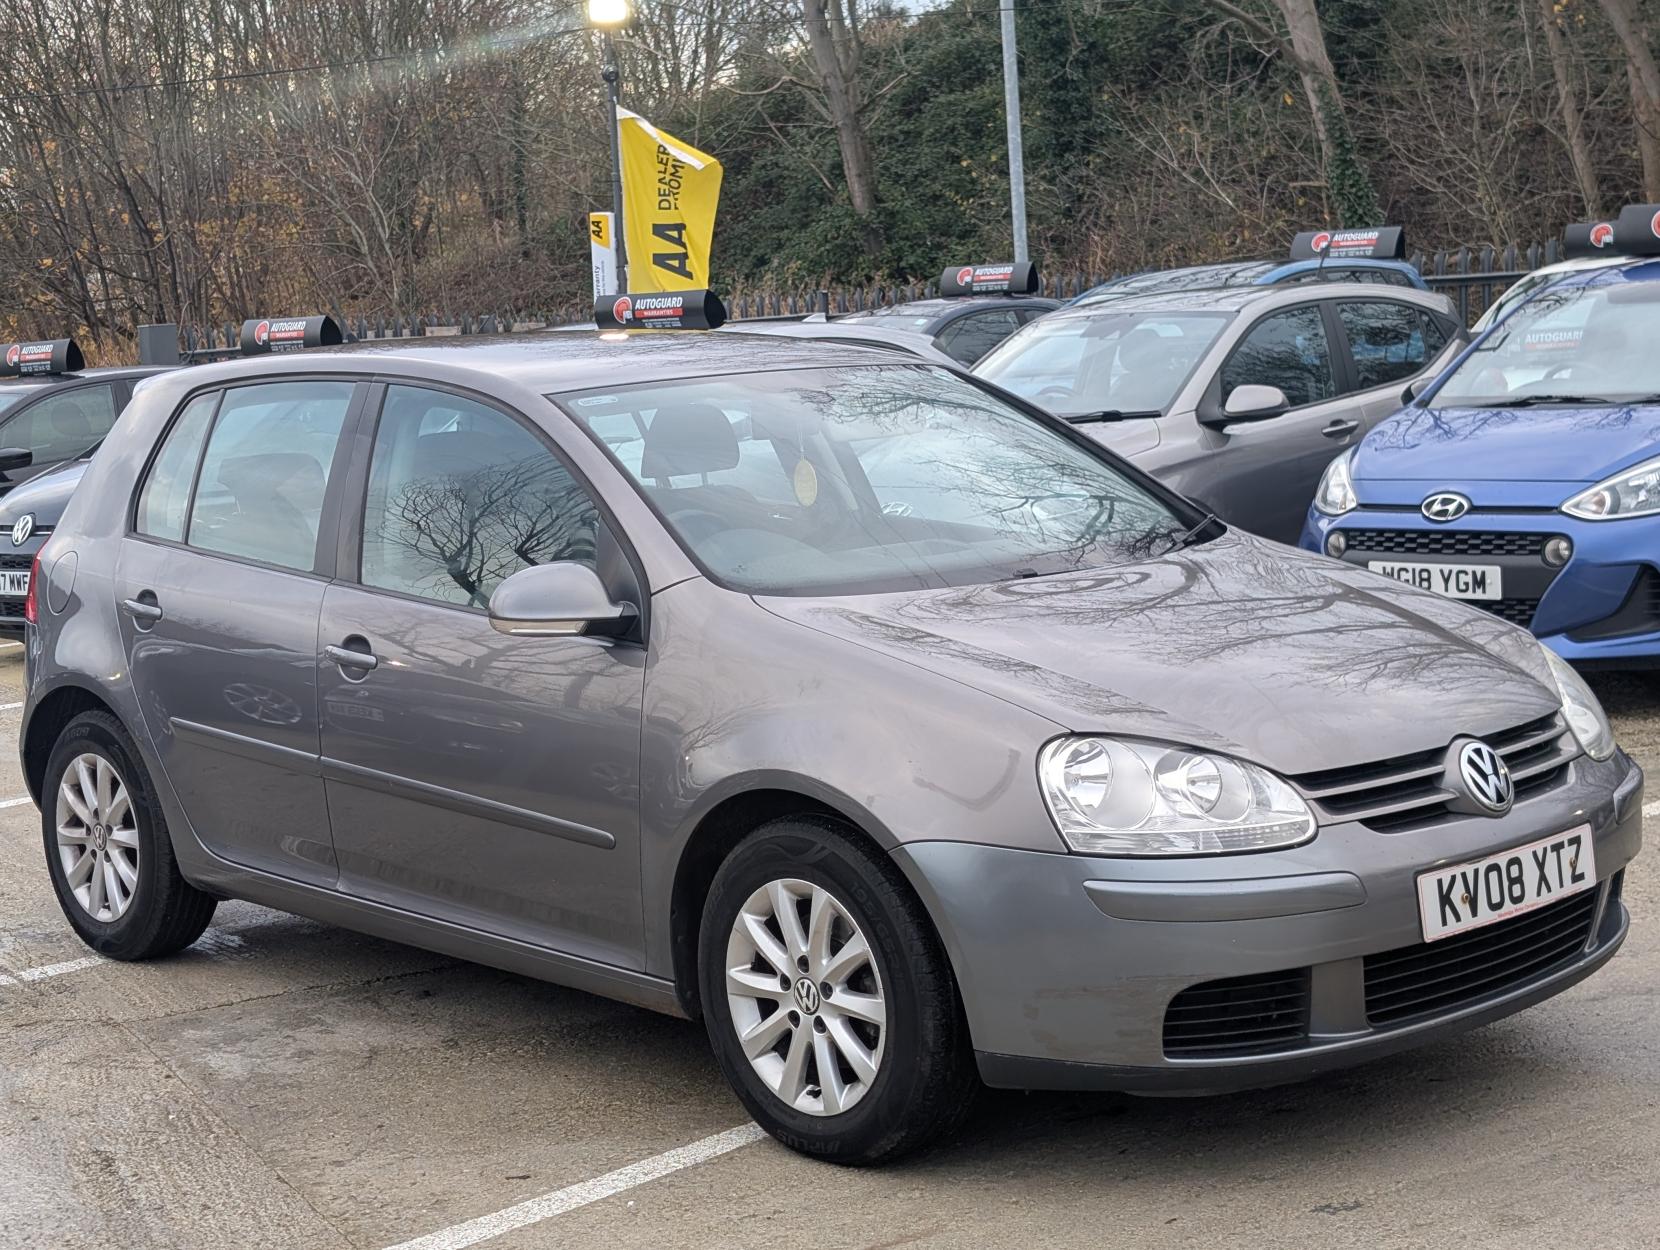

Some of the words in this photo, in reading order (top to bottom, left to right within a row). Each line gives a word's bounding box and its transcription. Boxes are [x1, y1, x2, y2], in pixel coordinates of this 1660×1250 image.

[657, 144, 671, 210] DEALER
[592, 220, 602, 239] AA
[1332, 231, 1379, 242] AUTOGUARD
[652, 222, 694, 281] AA
[975, 266, 1014, 275] AUTOGUARD
[634, 296, 683, 310] AUTOGUARD
[270, 320, 306, 332] AUTOGUARD
[21, 344, 54, 354] AUTOGUARD
[8, 573, 29, 592] MWF
[1440, 568, 1486, 594] YGM
[1436, 856, 1526, 928] KV08
[1531, 834, 1586, 897] XTZ
